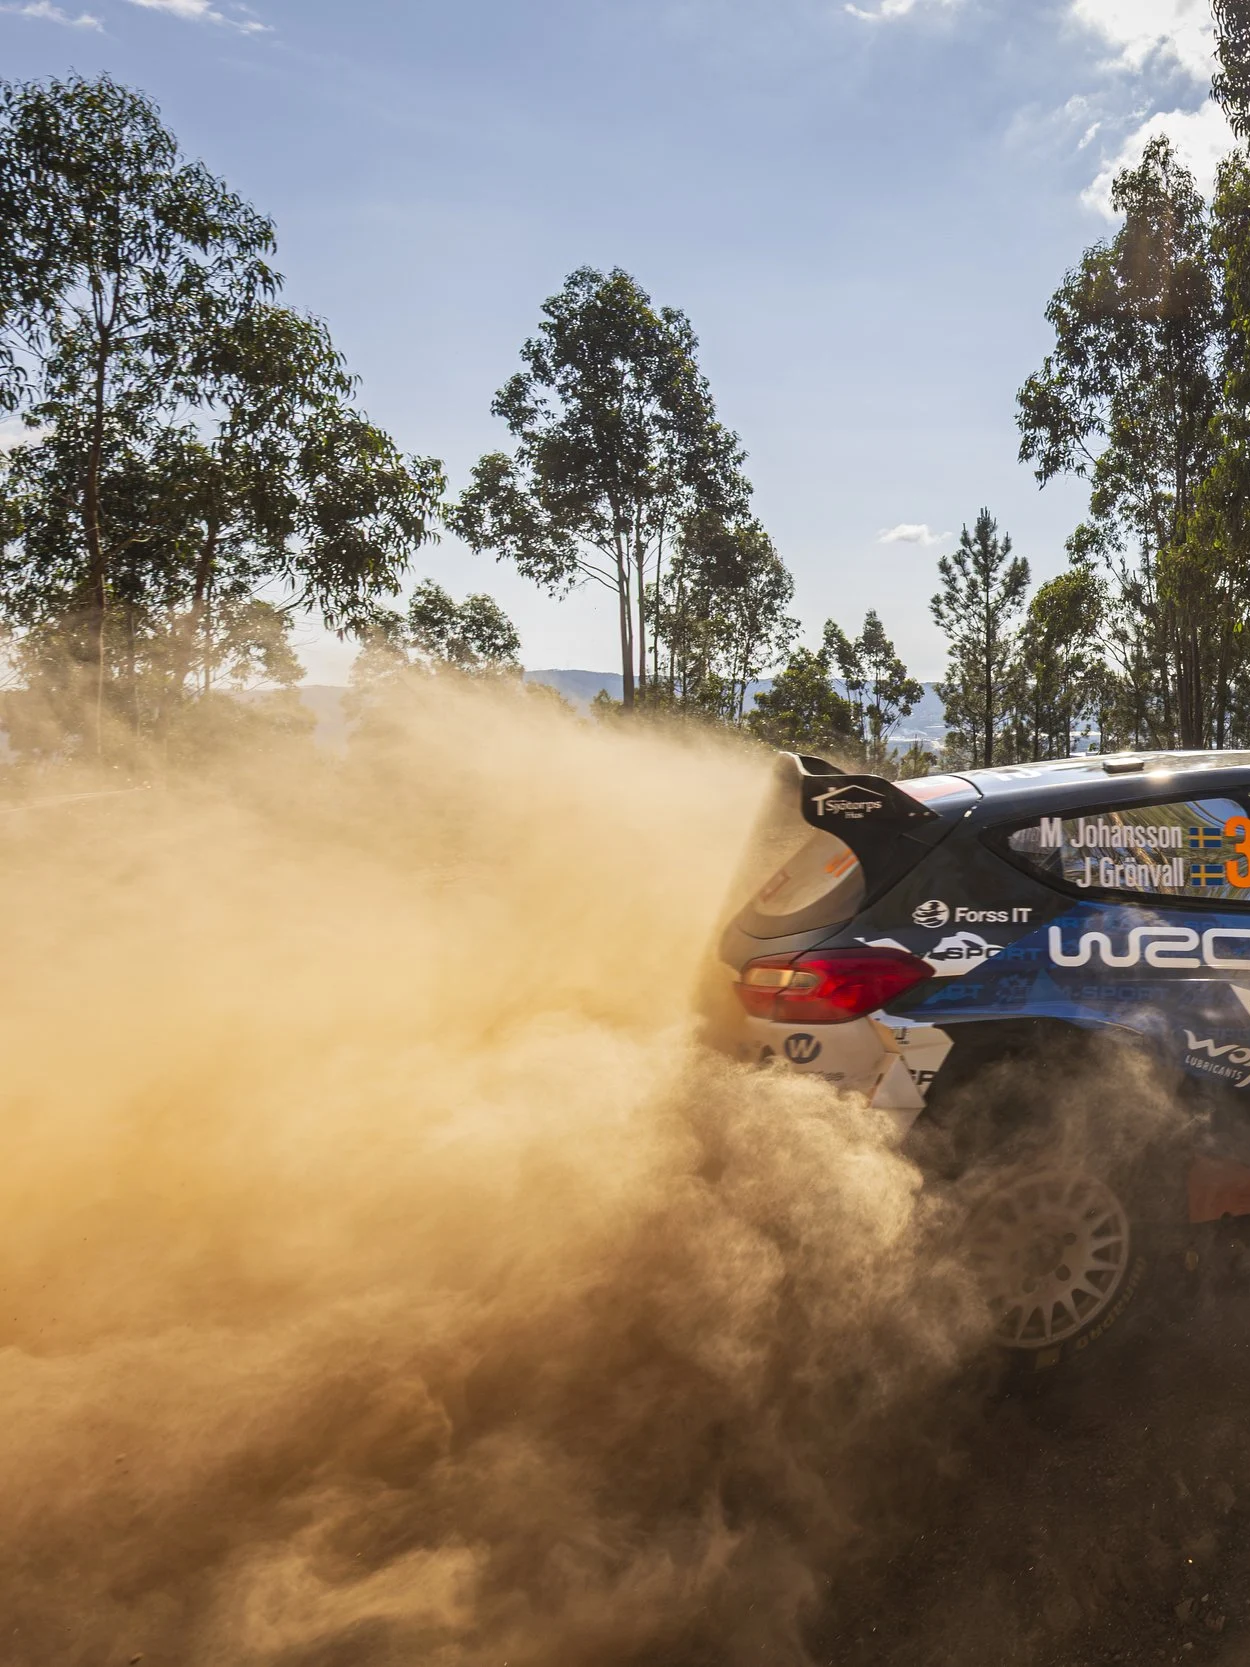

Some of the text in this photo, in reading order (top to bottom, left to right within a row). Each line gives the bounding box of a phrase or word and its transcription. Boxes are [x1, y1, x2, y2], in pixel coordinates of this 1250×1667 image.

[1039, 817, 1183, 848] M Johansson
[1075, 856, 1185, 888] J Grönvall
[954, 907, 1009, 923] Forss
[1012, 907, 1032, 923] IT
[1185, 1055, 1244, 1081] LUBRICANTS
